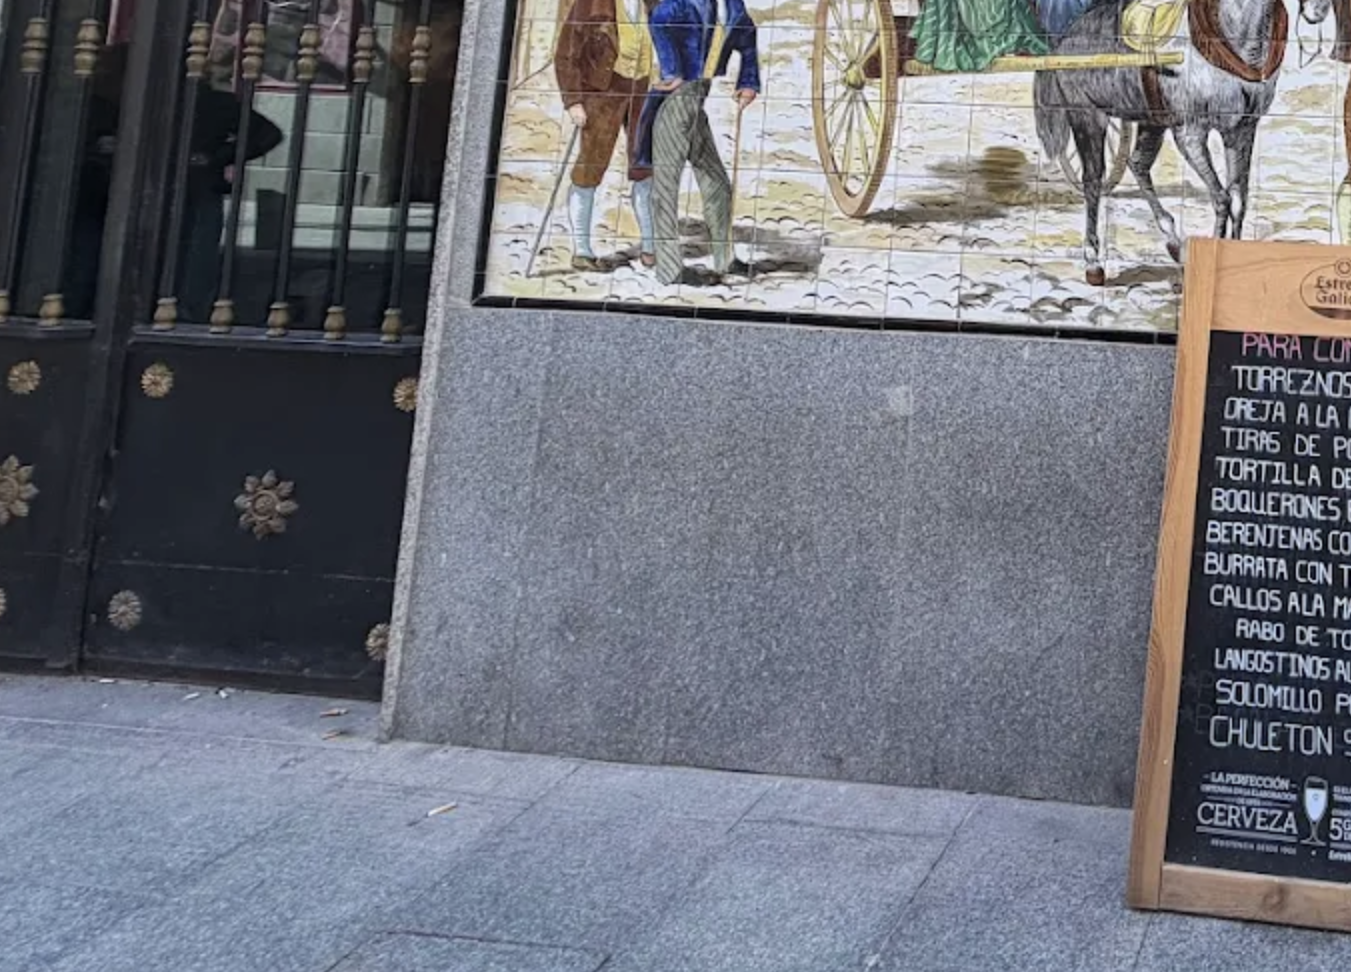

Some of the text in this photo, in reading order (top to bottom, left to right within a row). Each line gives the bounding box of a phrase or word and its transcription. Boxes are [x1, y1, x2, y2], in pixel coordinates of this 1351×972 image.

[1241, 332, 1302, 360] PARA
[1223, 397, 1286, 423] OREJA
[1296, 402, 1310, 427] A
[1315, 404, 1340, 429] LA
[1221, 426, 1281, 453] TIRAS
[1294, 433, 1320, 457] DE
[1215, 456, 1321, 487] TORTILLA
[1211, 487, 1340, 521] BOQUERONES
[1206, 520, 1323, 551] BERENJENAS
[1204, 551, 1288, 580] BURRATA
[1295, 560, 1332, 586] CON
[1209, 583, 1282, 612] CALLOS
[1236, 618, 1285, 642] RABO
[1295, 625, 1320, 647] DE
[1214, 647, 1330, 681] LANGOSTINOS
[1215, 679, 1322, 713] SOLOMILLO
[1209, 715, 1333, 756] CHULETON
[1197, 801, 1299, 834] CERVEZA
[1328, 817, 1343, 841] 5
